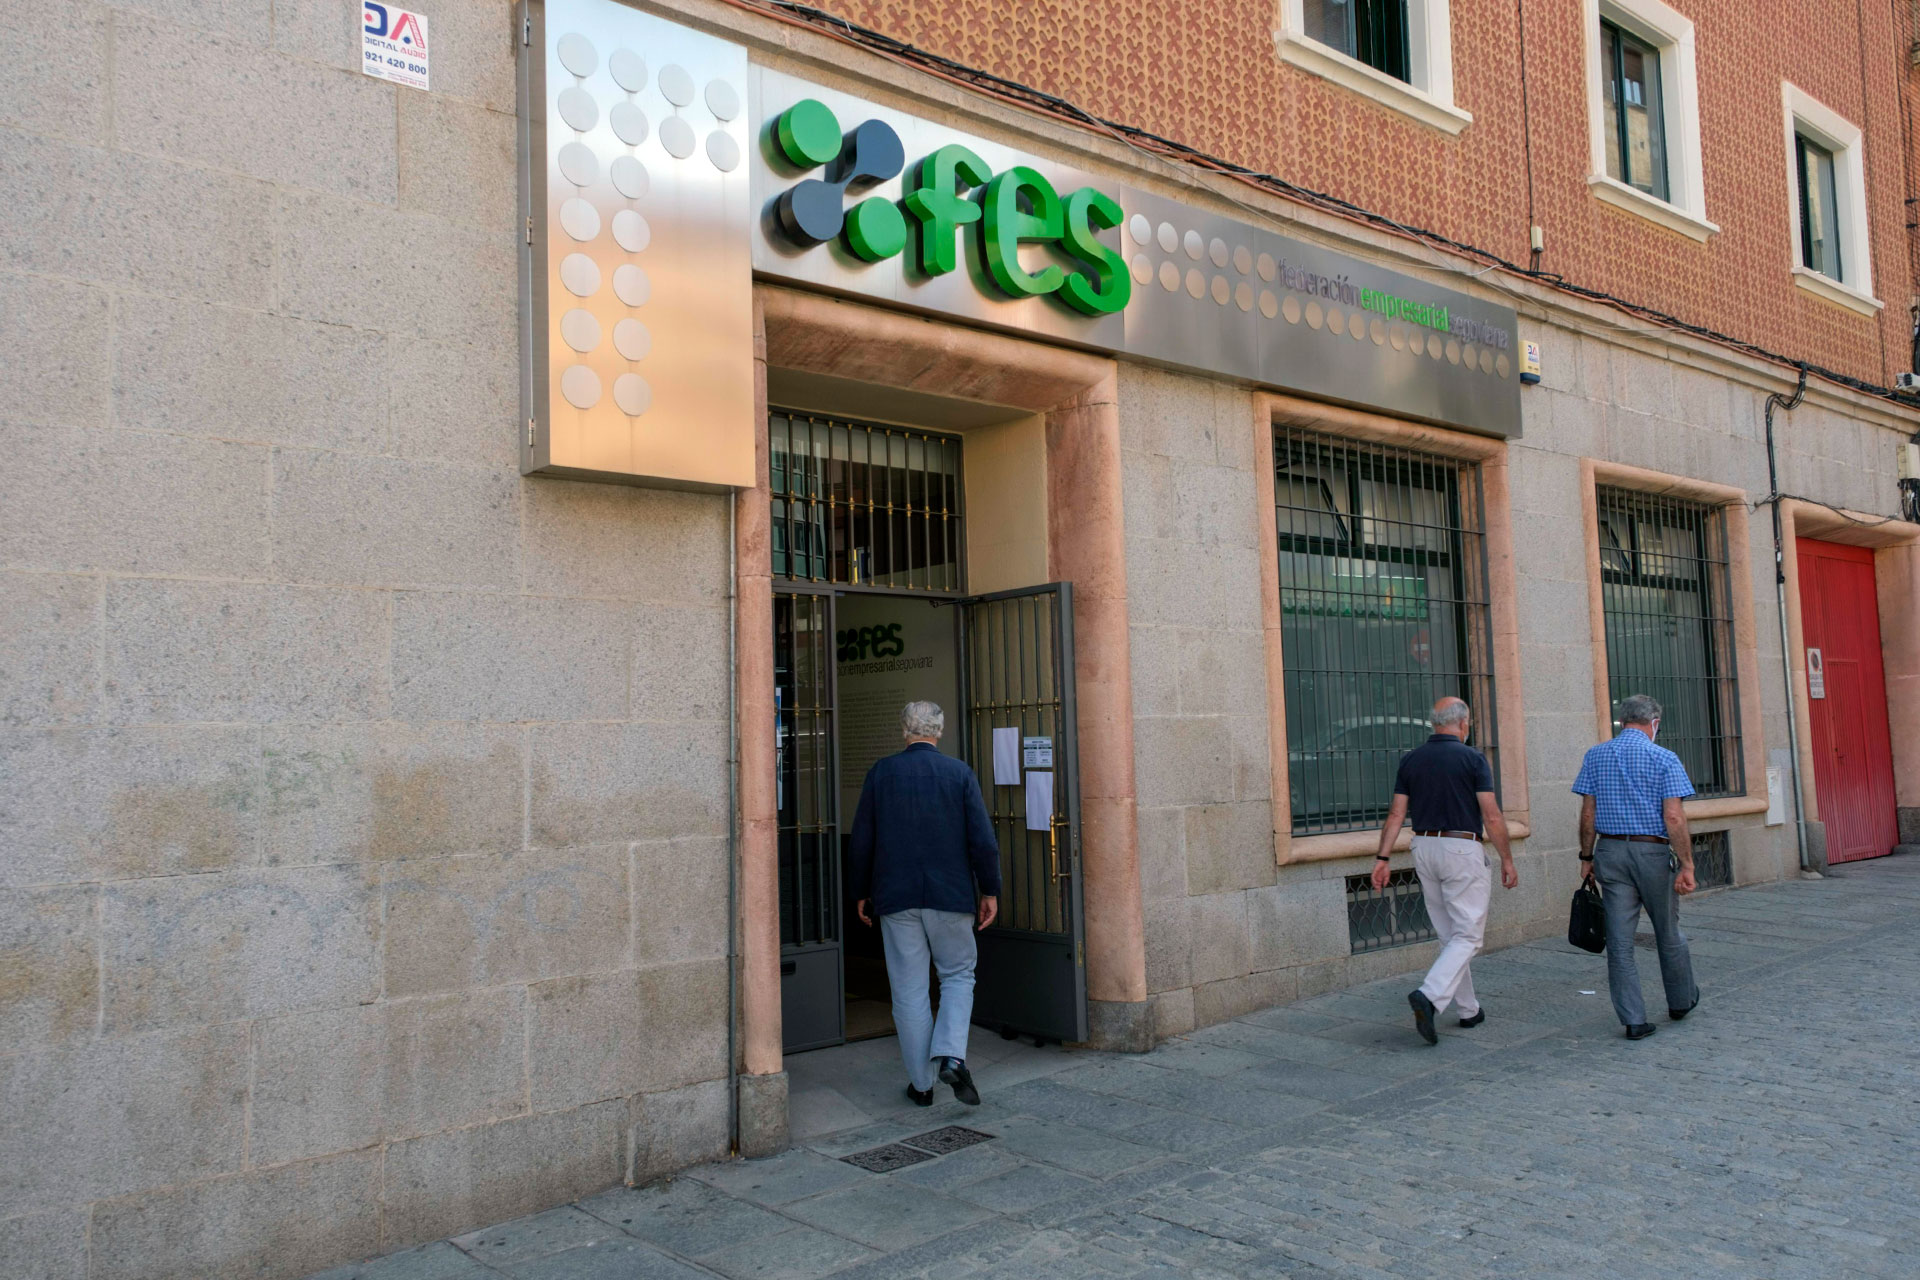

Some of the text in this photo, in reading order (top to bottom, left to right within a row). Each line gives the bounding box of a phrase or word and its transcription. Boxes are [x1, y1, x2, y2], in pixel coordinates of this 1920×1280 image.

[365, 36, 427, 60] DIGITAL AUDIO
[365, 51, 427, 75] 921 420 800
[905, 144, 1132, 316] fes
[856, 622, 905, 660] fes
